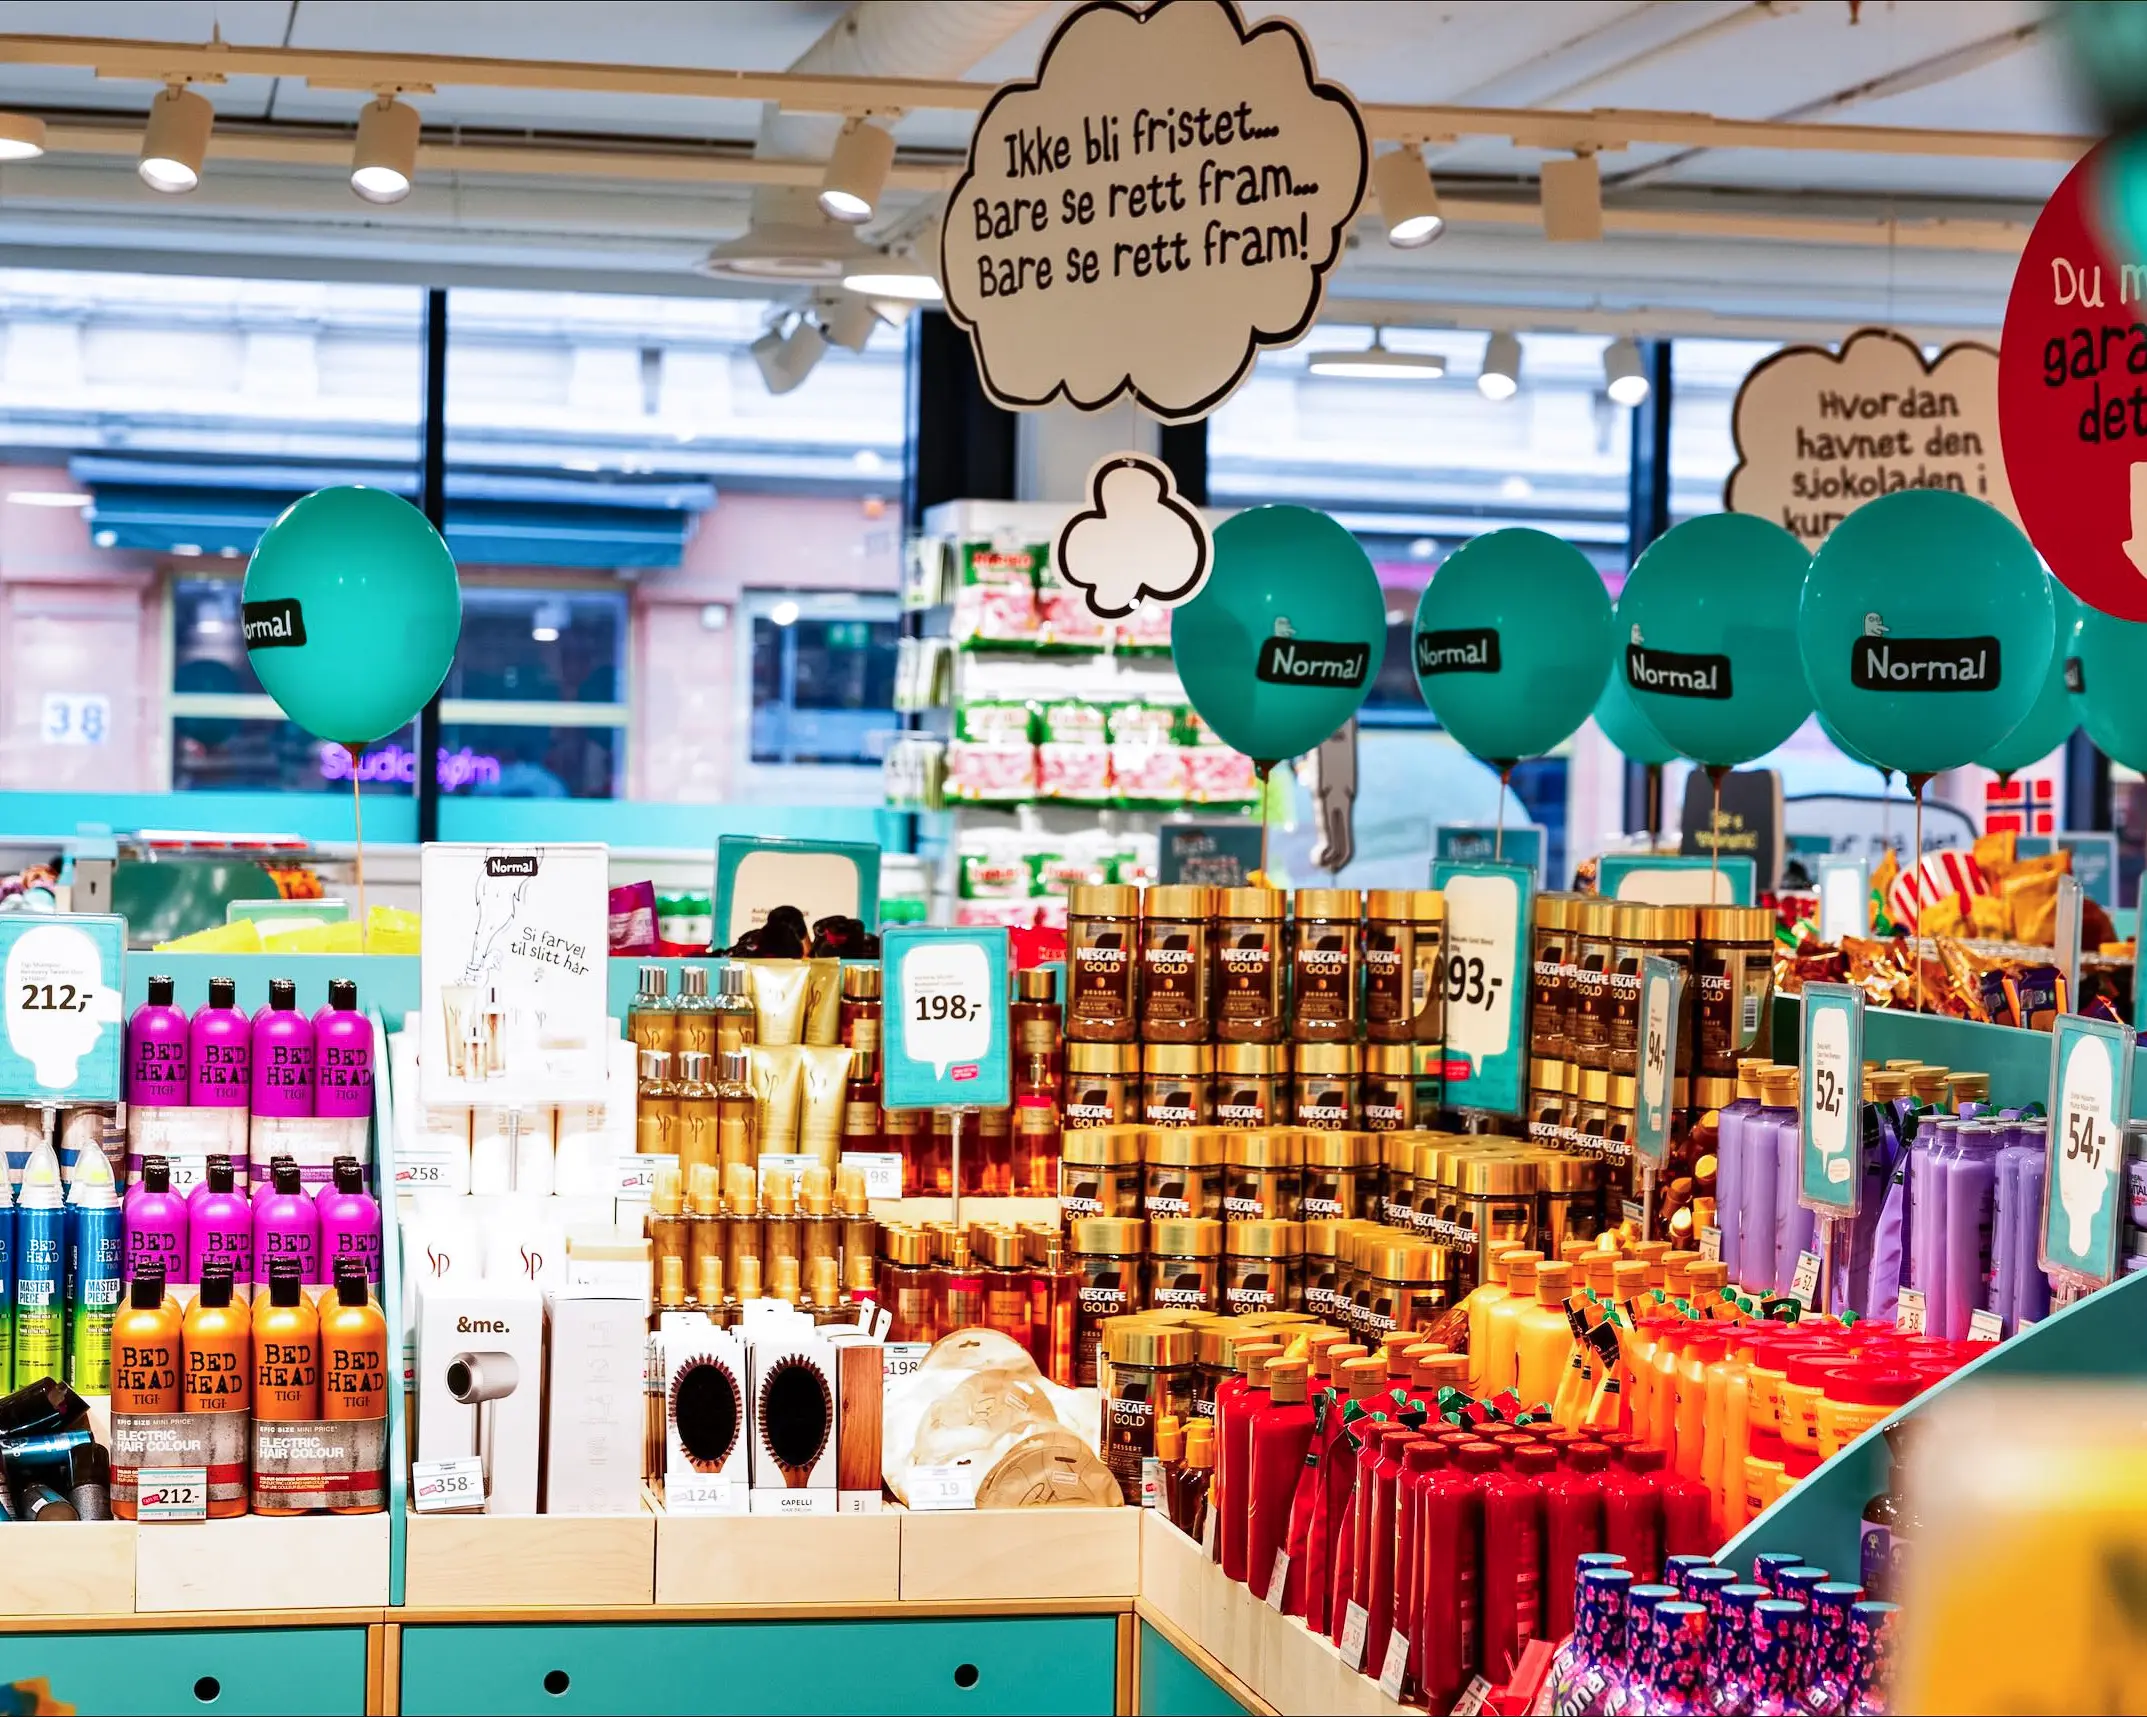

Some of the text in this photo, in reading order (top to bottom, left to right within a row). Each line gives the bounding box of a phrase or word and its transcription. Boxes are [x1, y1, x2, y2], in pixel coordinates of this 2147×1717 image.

[1003, 101, 1279, 178] Ikke bli fristet...
[973, 159, 1319, 241] Bare se rett fram...
[978, 211, 1308, 298] Bare se rett fram!
[2051, 257, 2105, 308] Du
[1819, 387, 1959, 420] Hvordan
[2079, 381, 2147, 444] det
[1797, 426, 1982, 461] havnet den
[1792, 466, 1964, 500] sjokoladen
[1419, 639, 1488, 667] Normal
[1272, 646, 1364, 679] Normal
[1633, 653, 1718, 690] Normal
[1867, 646, 1987, 681] Normal
[491, 860, 533, 873] Normal
[523, 926, 586, 959] Si farvel
[511, 942, 526, 956] til
[530, 946, 560, 965] slitt
[1084, 962, 1120, 973] GOLD
[1153, 963, 1188, 974] GOLD
[1228, 962, 1263, 973] GOLD
[1306, 964, 1341, 975] GOLD
[1369, 964, 1395, 975] GOLD
[1536, 976, 1560, 988] GOLD
[1578, 984, 1602, 996] GOLD
[22, 984, 93, 1013] 212,-
[916, 995, 982, 1022] 198,-
[142, 1041, 183, 1060] BED
[206, 1045, 246, 1063] BED
[273, 1046, 313, 1065] BED
[327, 1048, 367, 1066] BED
[320, 1067, 371, 1086] HEAD
[1816, 1069, 1844, 1117] 52,-
[1073, 1119, 1106, 1129] GOLD
[1155, 1120, 1190, 1129] GOLD
[1224, 1119, 1256, 1129] GOLD
[1307, 1119, 1341, 1130] GOLD
[1369, 1119, 1396, 1130] GOLD
[2067, 1113, 2106, 1170] 54,-
[639, 1173, 654, 1185] 14
[1065, 1211, 1096, 1220] GOLD
[1150, 1211, 1182, 1220] GOLD
[1227, 1211, 1255, 1221] GOLD
[30, 1240, 56, 1251] BED
[131, 1231, 176, 1250] BED
[208, 1232, 249, 1251] BED
[267, 1232, 311, 1252] BED
[339, 1233, 379, 1252] BED
[27, 1252, 60, 1263] HEAD
[19, 1281, 50, 1293] MASTER
[88, 1281, 118, 1292] MASTER
[19, 1293, 40, 1303] PIECE
[88, 1293, 110, 1303] PIECE
[1083, 1302, 1119, 1314] GOLD
[1233, 1302, 1268, 1313] GOLD
[456, 1316, 510, 1333] &me.
[122, 1347, 170, 1367] BED
[189, 1351, 236, 1372] BED
[264, 1344, 311, 1364] BED
[333, 1350, 379, 1370] BED
[117, 1369, 175, 1390] HEAD
[185, 1374, 242, 1394] HEAD
[259, 1366, 315, 1386] HEAD
[327, 1372, 384, 1392] HEAD
[1114, 1413, 1145, 1426] GOLD
[117, 1430, 177, 1441] ELECTRIC
[259, 1437, 321, 1448] ELECTRIC
[117, 1440, 200, 1452] HAIR COLOUR
[259, 1447, 344, 1458] HAIR COLOUR
[1113, 1443, 1142, 1451] DESSERT
